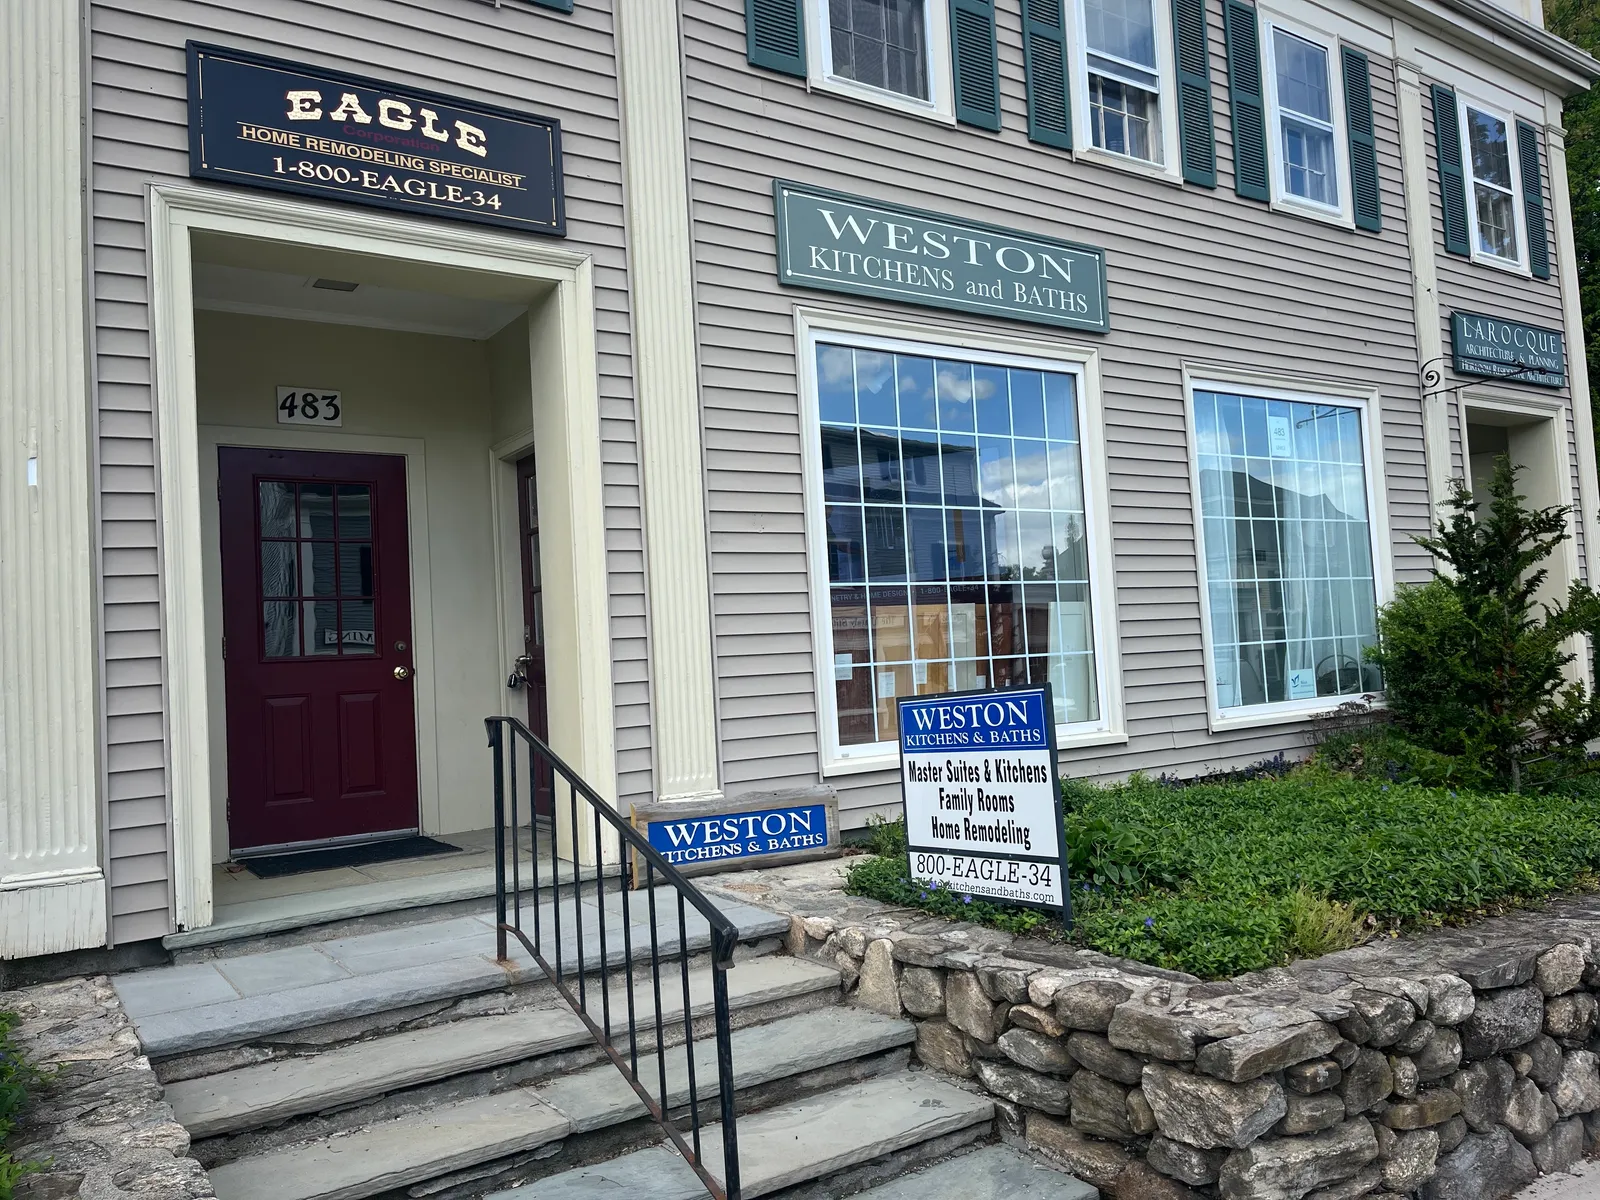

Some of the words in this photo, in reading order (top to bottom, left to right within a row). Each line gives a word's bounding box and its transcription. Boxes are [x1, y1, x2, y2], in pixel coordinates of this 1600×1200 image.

[285, 89, 488, 158] EAGLE
[342, 124, 441, 152] Corporation
[242, 126, 301, 148] HOME
[305, 137, 425, 171] REMODELING
[429, 161, 522, 187] SPECIALIST
[273, 156, 502, 210] 1-800-EAGLE-34
[817, 208, 1074, 283] WESTON
[809, 245, 955, 291] KITCHENS
[966, 279, 1003, 300] and
[1013, 281, 1088, 314] BATHS
[1463, 317, 1558, 355] LAROCQUE
[1465, 343, 1514, 362] ARCHITECTURE
[1519, 352, 1525, 364] &
[1528, 354, 1559, 370] PLANNING
[279, 391, 341, 421] 483
[1273, 427, 1286, 437] 483
[860, 591, 881, 600] HME
[912, 700, 1028, 730] WESTON
[906, 732, 969, 746] KITCHENS
[973, 731, 985, 744] &
[990, 729, 1041, 743] BATHS
[908, 760, 943, 783] Master
[946, 759, 980, 783] Suites
[984, 759, 992, 783] &
[995, 759, 1048, 784] Kitchens
[939, 788, 974, 816] Family
[977, 788, 1015, 813] Rooms
[663, 810, 812, 848] WESTON
[747, 840, 762, 852] &
[767, 832, 824, 851] BATHS
[931, 816, 960, 840] Home
[963, 817, 1032, 851] Remodeling
[917, 853, 1052, 888] 800-EAGLE-34
